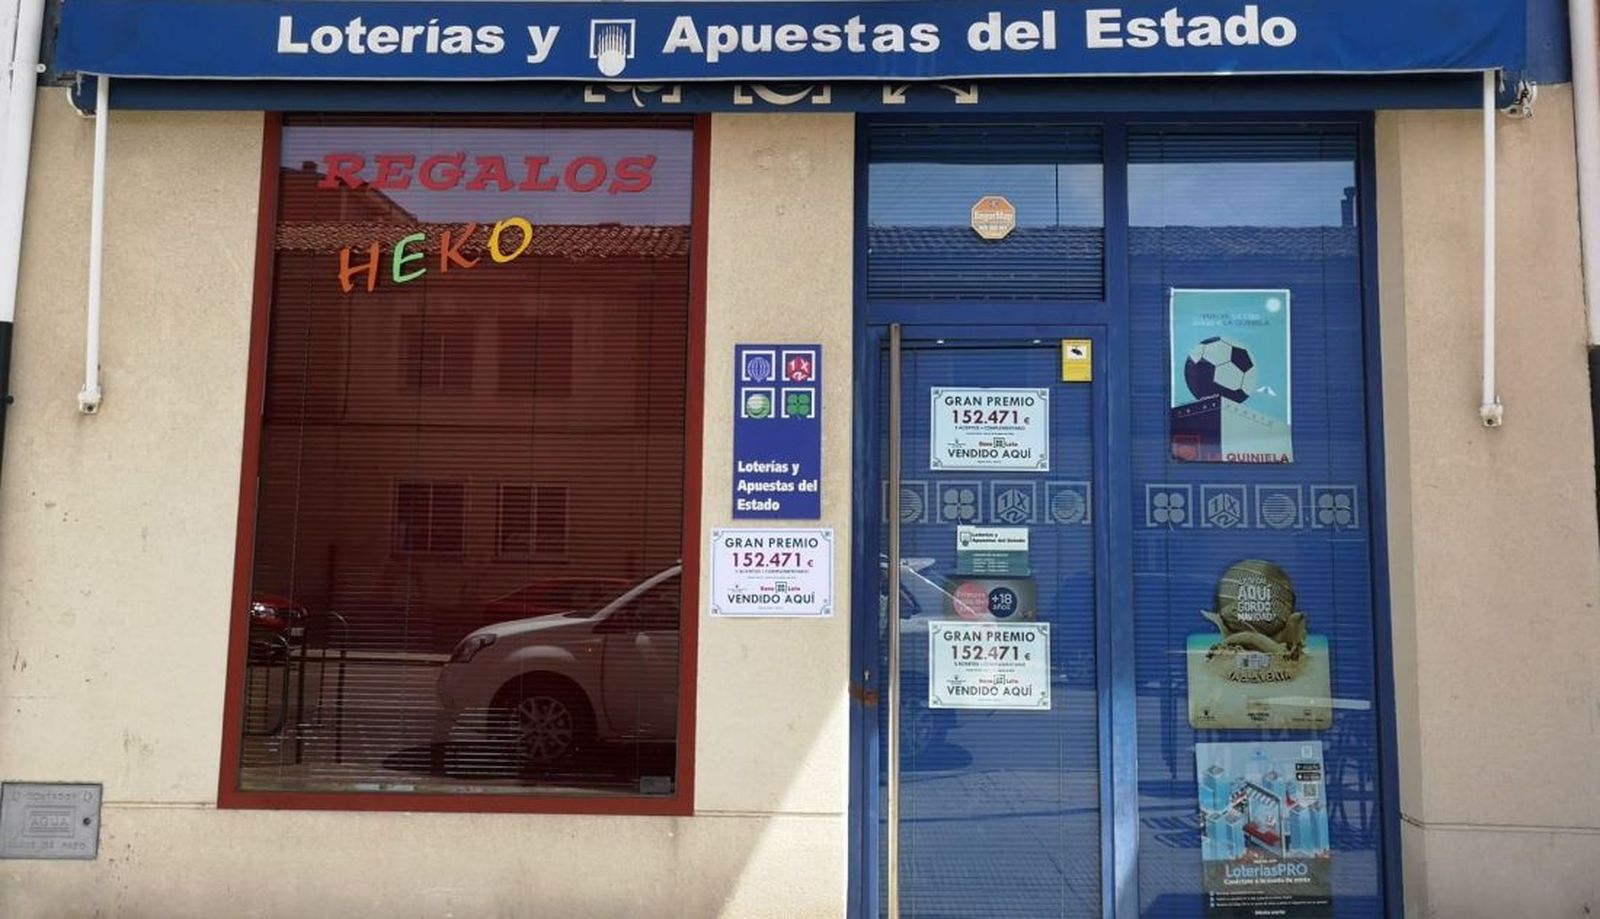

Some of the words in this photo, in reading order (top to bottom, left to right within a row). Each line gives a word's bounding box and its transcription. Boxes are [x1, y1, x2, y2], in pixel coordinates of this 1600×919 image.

[277, 16, 505, 54] Loterías
[526, 25, 561, 63] y
[662, 15, 941, 63] Apuestas
[967, 10, 1057, 51] del
[1086, 5, 1297, 48] Estado
[318, 152, 657, 194] REGALOS
[338, 216, 533, 293] HEKO
[944, 396, 982, 406] GRAN
[987, 396, 1035, 407] PREMIO
[952, 410, 1018, 424] 152.471
[948, 449, 999, 458] VENDIDO
[1002, 448, 1032, 459] AQUÍ
[1227, 453, 1290, 464] QUINIELA
[737, 460, 789, 473] Loterías
[791, 462, 800, 476] y
[737, 479, 795, 494] Apuestas
[798, 479, 818, 492] del
[737, 498, 781, 511] Estado
[725, 538, 764, 548] GRAN
[768, 538, 819, 548] PREMIO
[733, 552, 801, 567] 152.471
[728, 594, 781, 604] VENDIDO
[784, 592, 815, 604] AQUÍ
[991, 593, 1013, 604] +18
[1237, 584, 1272, 600] AQUÍ
[944, 631, 981, 641] GRAN
[987, 631, 1035, 642] PREMIO
[951, 645, 1019, 660] 152.471
[947, 686, 999, 696] VENDIDO
[1002, 684, 1032, 696] AQUÍ
[30, 815, 69, 827] AGUA
